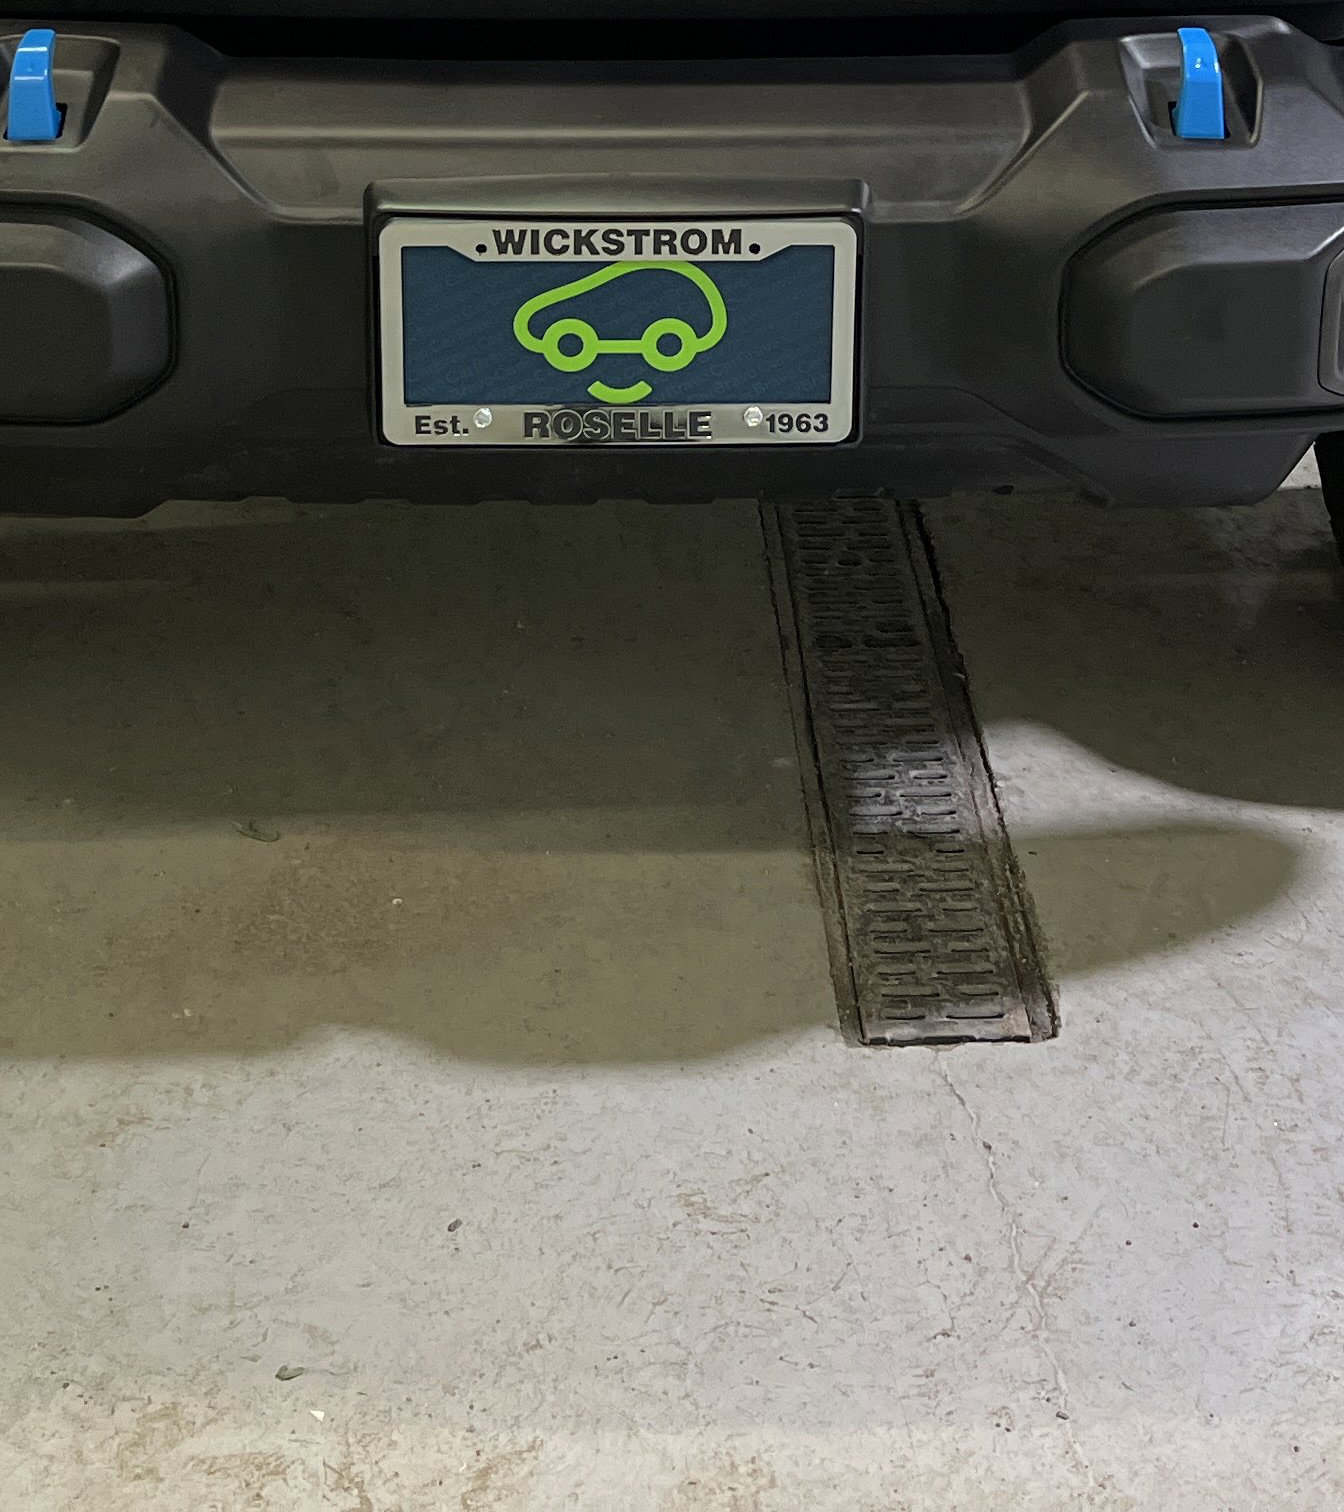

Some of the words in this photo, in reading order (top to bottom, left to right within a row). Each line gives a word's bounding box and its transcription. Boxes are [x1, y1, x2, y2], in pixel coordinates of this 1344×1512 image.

[492, 228, 742, 256] WICKSTROM
[415, 415, 469, 435] Est.
[522, 410, 712, 440] ROSELLE
[765, 413, 829, 433] 1963
